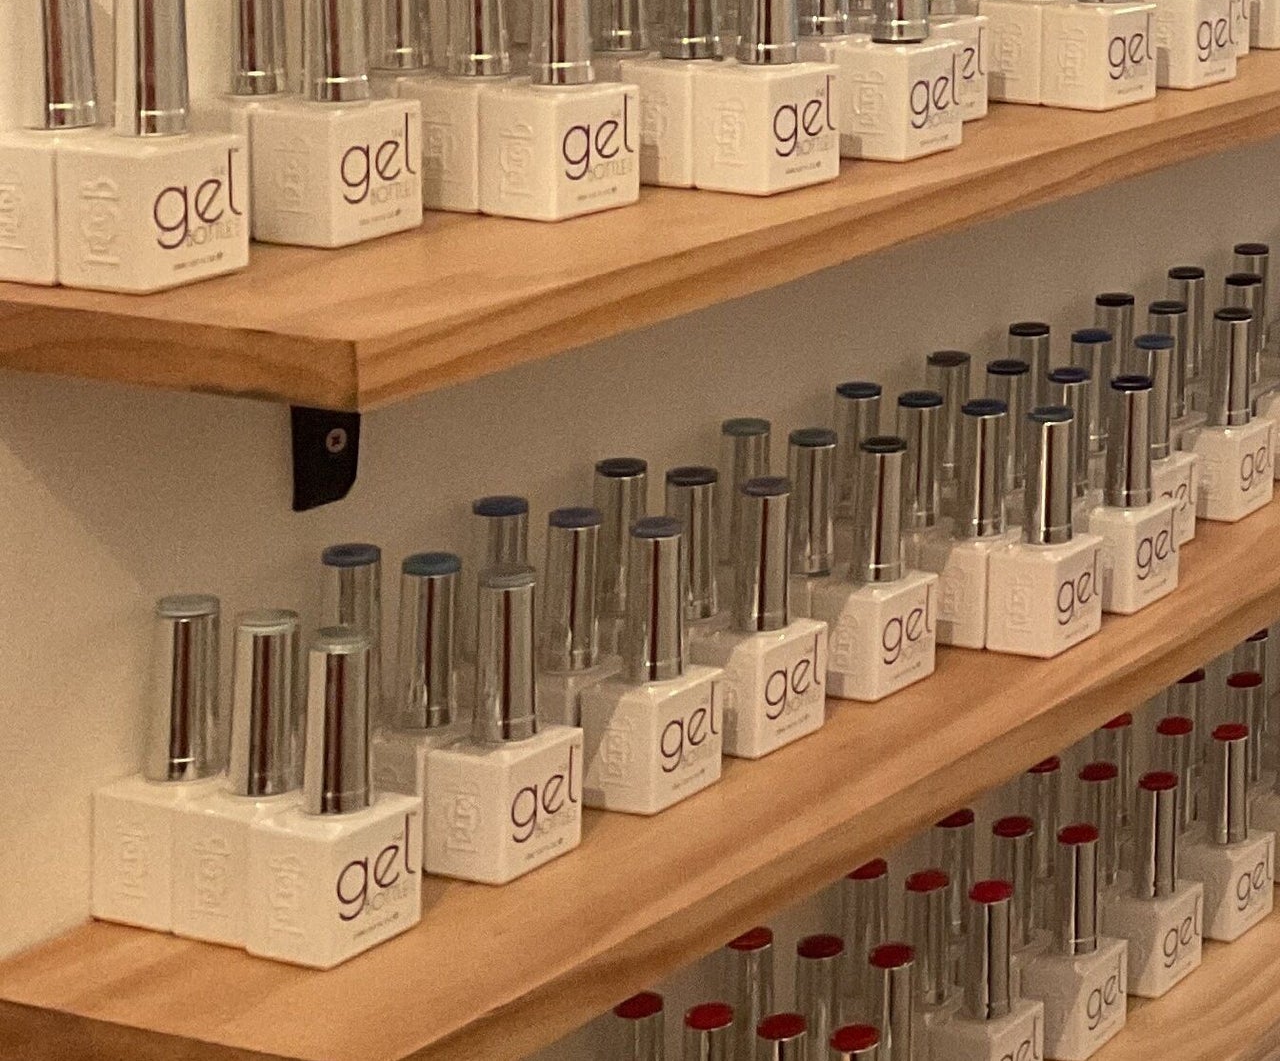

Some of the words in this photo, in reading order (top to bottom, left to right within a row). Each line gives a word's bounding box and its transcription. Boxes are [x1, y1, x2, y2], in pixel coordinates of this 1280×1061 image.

[1108, 12, 1152, 80] gel
[1197, 1, 1234, 62] gel
[773, 74, 836, 157] gel
[910, 53, 959, 129] gel
[341, 112, 416, 204] gel
[562, 93, 634, 180] gel
[153, 148, 242, 249] gel
[1241, 426, 1271, 491] gel
[1136, 507, 1175, 580] gel
[882, 585, 932, 664] gel
[1057, 549, 1099, 625] gel
[765, 634, 820, 720] gel
[661, 681, 719, 772] gel
[511, 745, 577, 843] gel
[337, 813, 415, 921] gel
[1237, 842, 1271, 911] gel
[1163, 896, 1199, 968] gel
[1087, 952, 1123, 1030] gel
[1000, 1016, 1039, 1061] el
